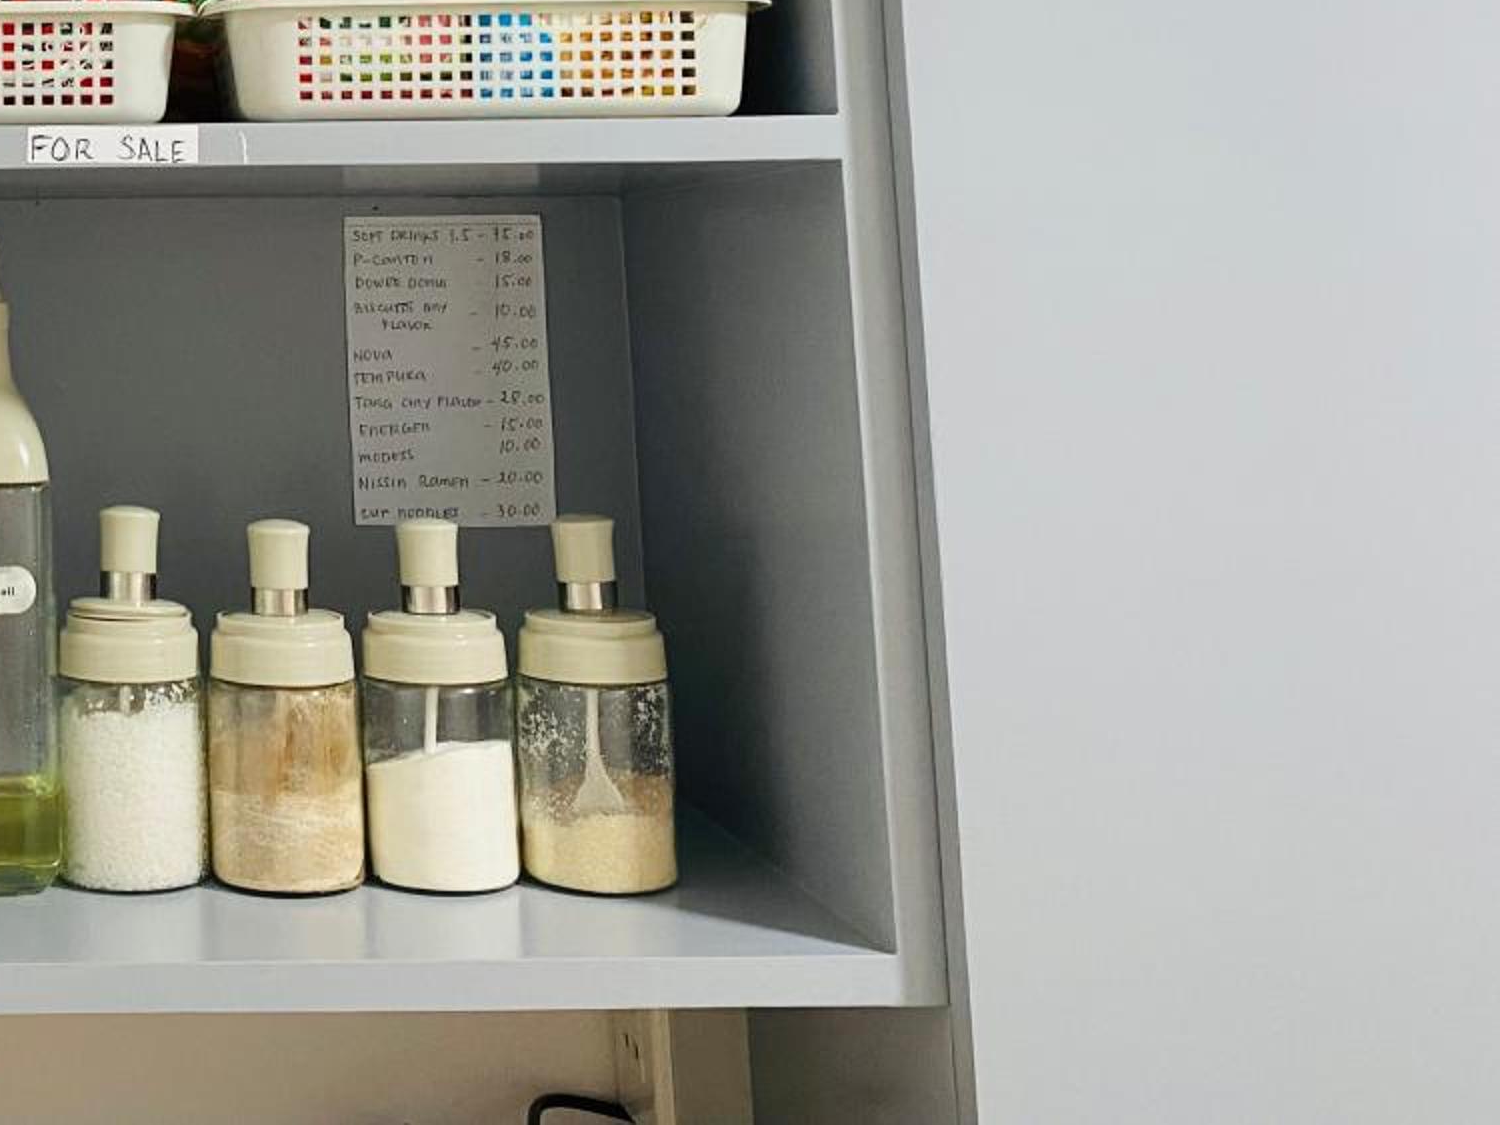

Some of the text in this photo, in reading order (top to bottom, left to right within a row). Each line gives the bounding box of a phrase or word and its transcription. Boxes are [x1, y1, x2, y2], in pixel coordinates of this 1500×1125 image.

[31, 133, 187, 163] FOR SALE
[494, 250, 533, 265] 18.00
[494, 305, 536, 321] 10.00
[490, 335, 539, 352] 45.00
[491, 359, 539, 376] 40.00
[500, 417, 543, 432] 15.00
[499, 437, 541, 454] 10.00
